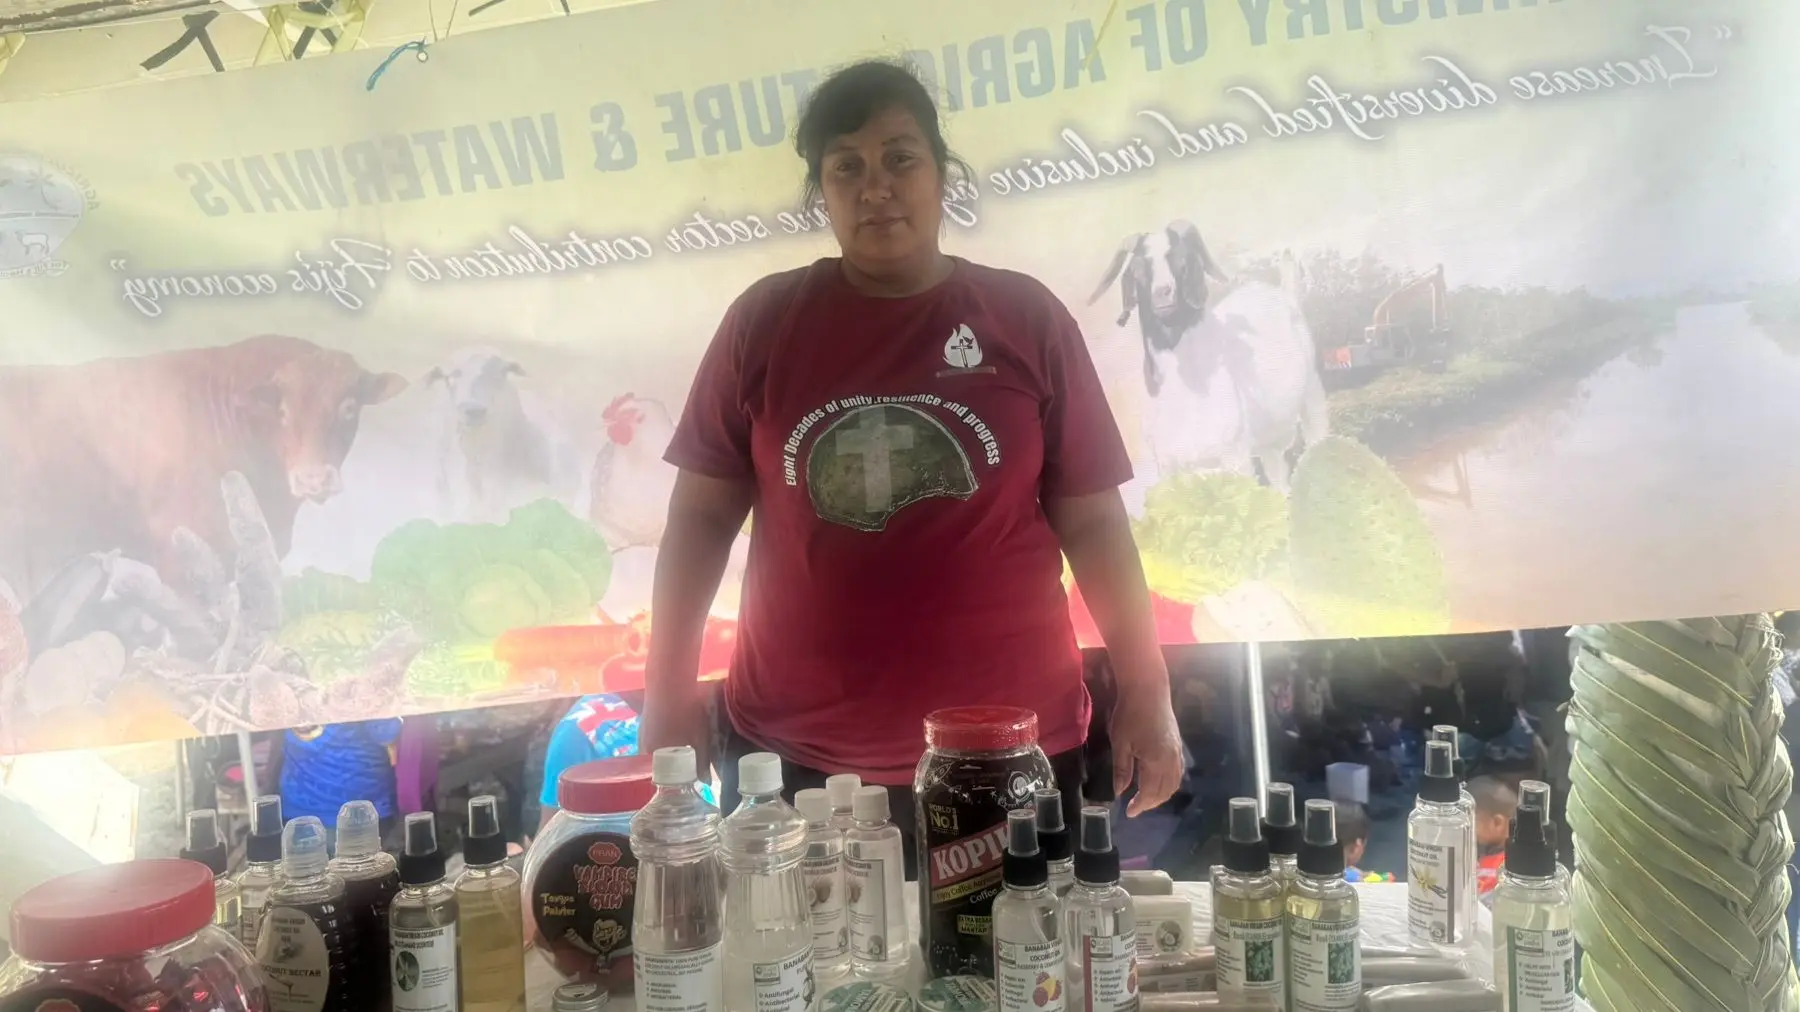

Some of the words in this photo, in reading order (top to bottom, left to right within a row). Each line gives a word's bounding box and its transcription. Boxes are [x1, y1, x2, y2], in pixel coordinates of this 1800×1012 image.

[826, 399, 842, 414] of
[943, 401, 969, 418] and
[784, 408, 826, 455] Decades
[963, 411, 1001, 466] progress
[784, 454, 798, 487] Eight
[932, 824, 1009, 880] KOPI
[969, 887, 999, 904] Coffee
